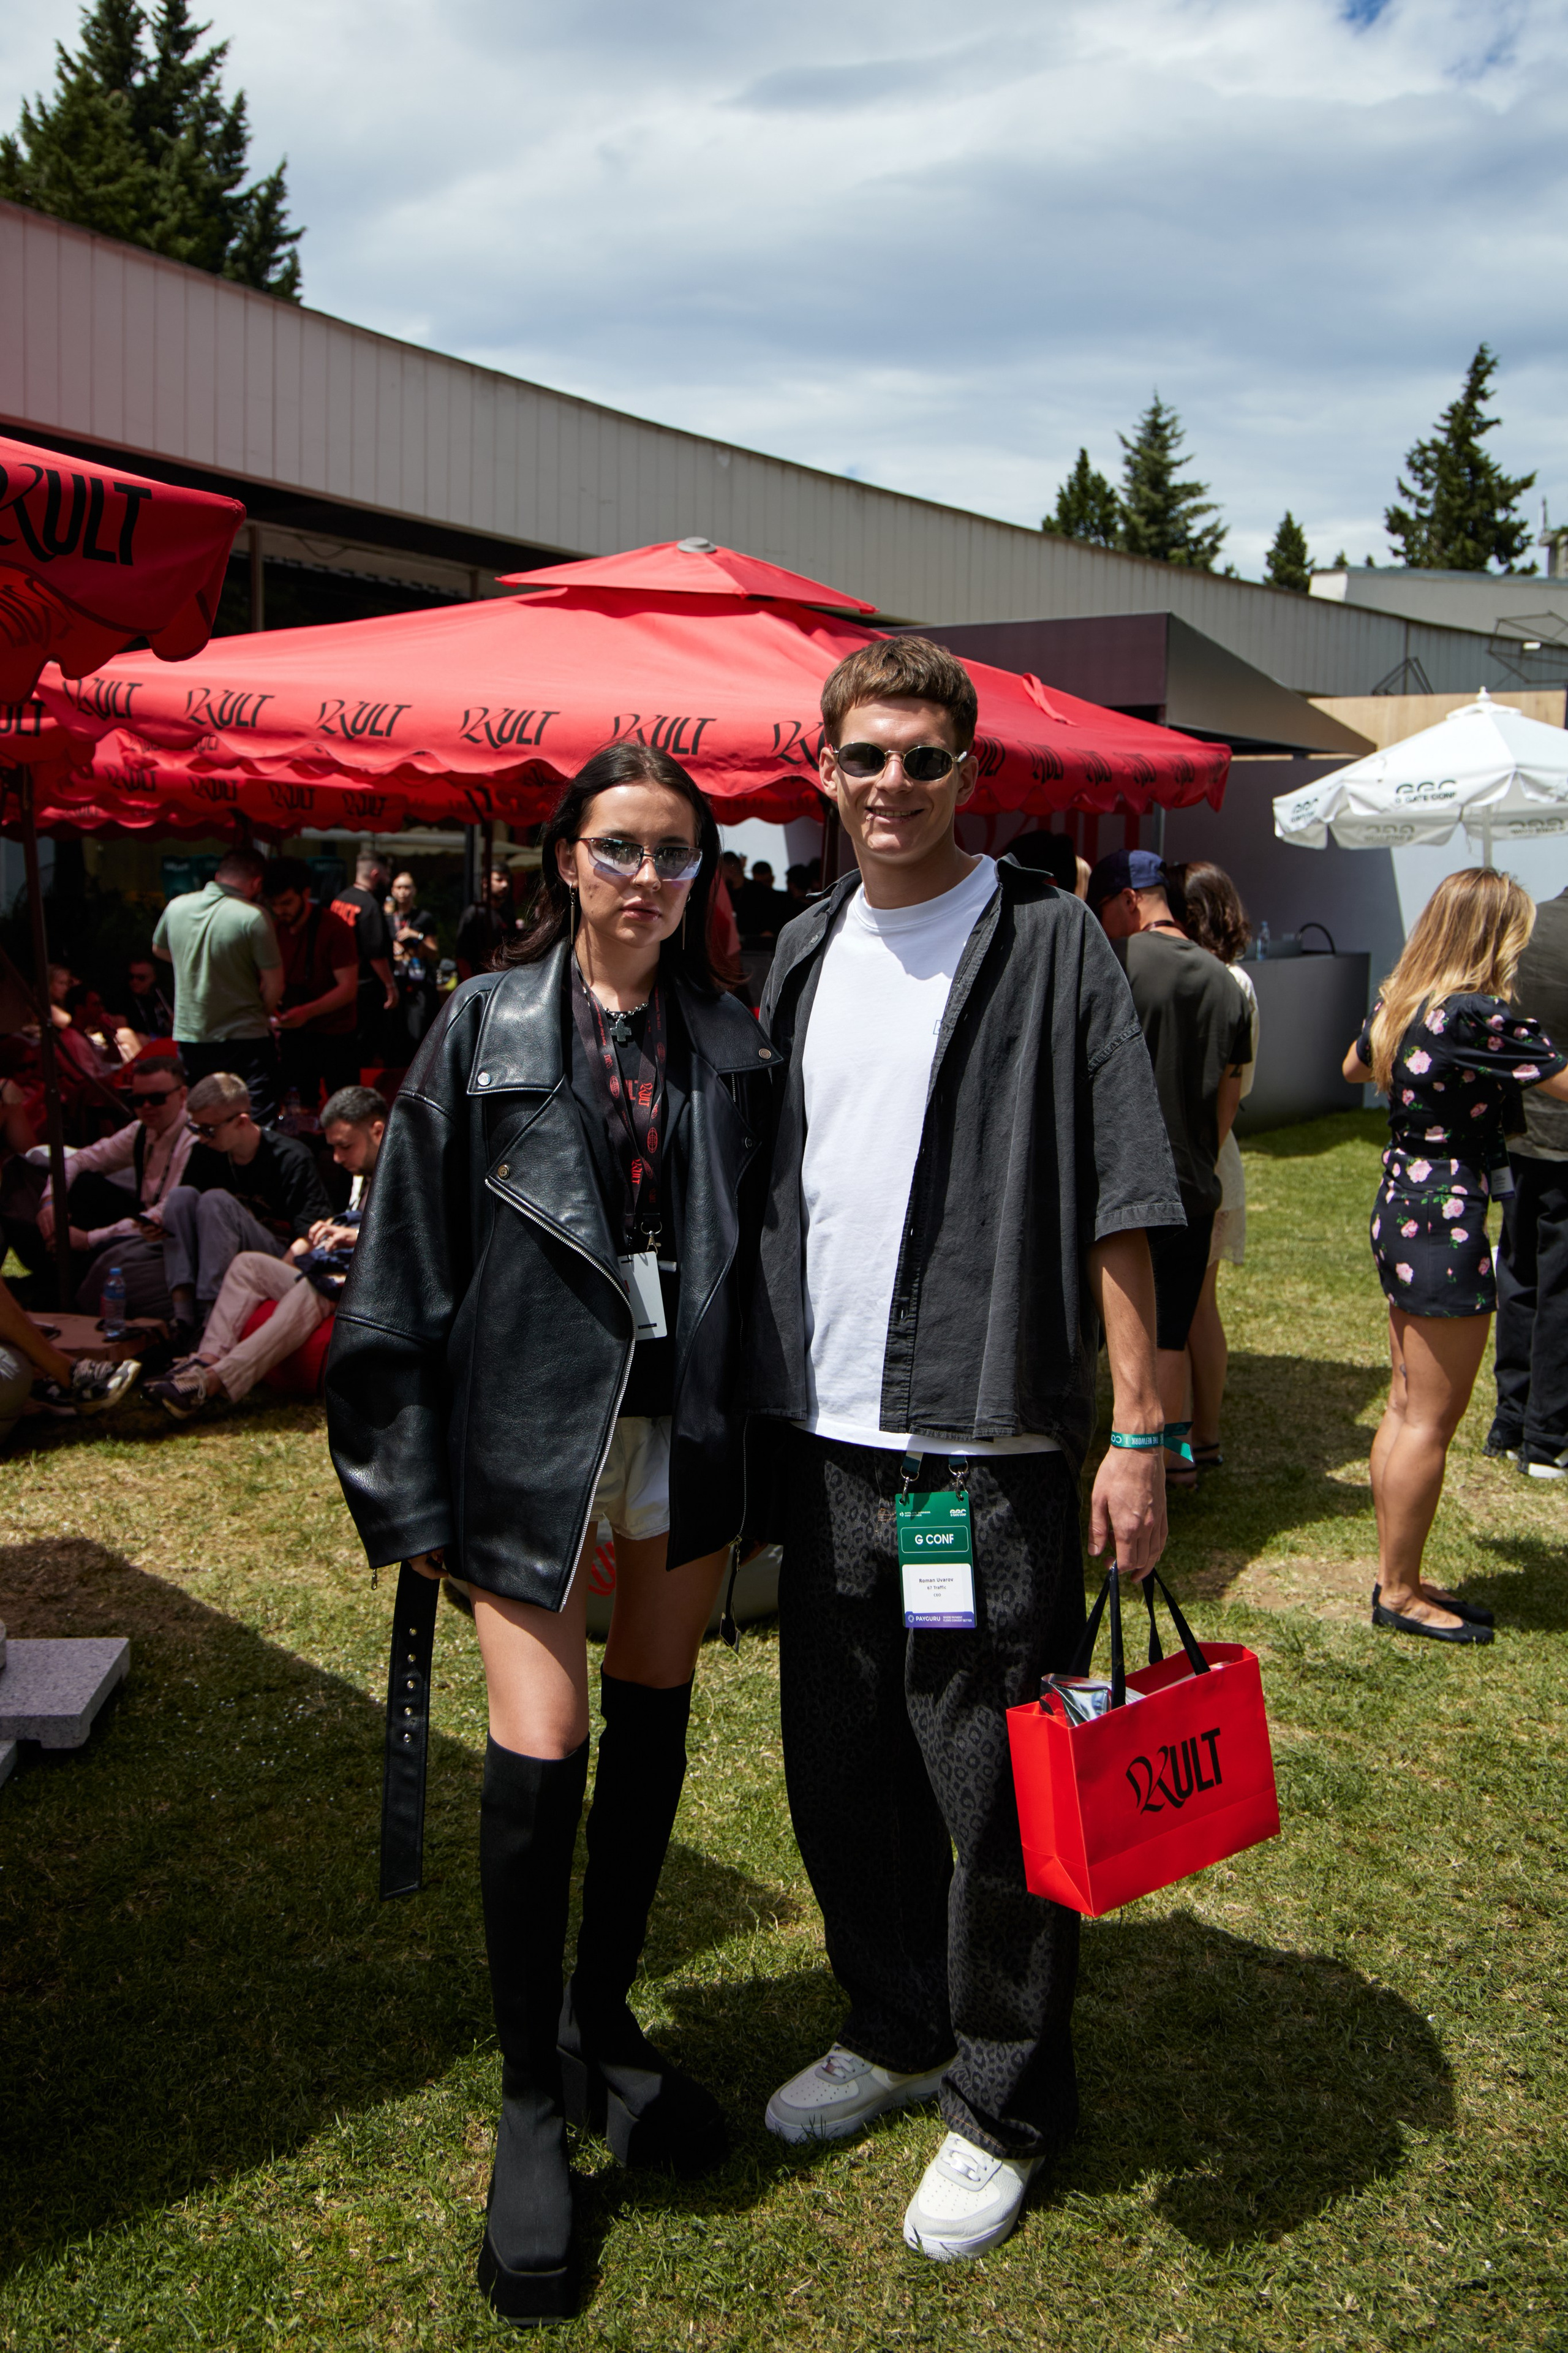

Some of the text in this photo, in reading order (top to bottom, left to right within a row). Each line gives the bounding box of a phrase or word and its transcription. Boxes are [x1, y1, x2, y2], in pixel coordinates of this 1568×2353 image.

[63, 677, 143, 721] KULT
[185, 687, 275, 730] KULT
[314, 699, 412, 740] KULT
[458, 707, 561, 749] KULT
[612, 713, 717, 755] KULT
[638, 1082, 653, 1108] KULT
[631, 1158, 642, 1184] KULT
[1131, 1437, 1152, 1445] NETWORK
[914, 1533, 954, 1545] G CONF
[1126, 1728, 1223, 1815] KULT
